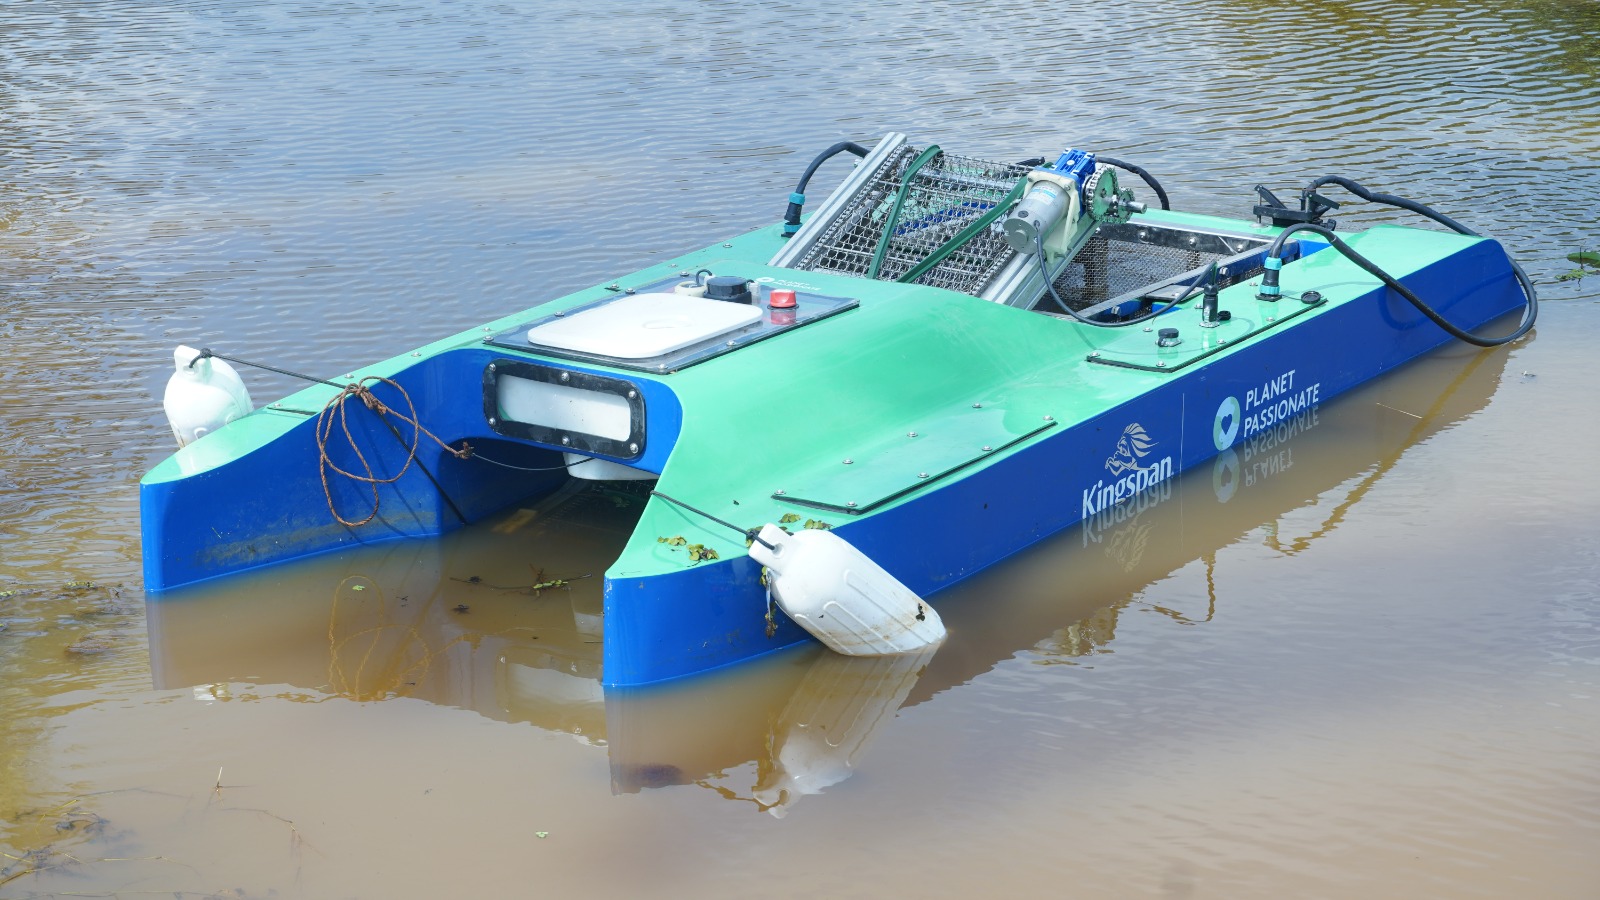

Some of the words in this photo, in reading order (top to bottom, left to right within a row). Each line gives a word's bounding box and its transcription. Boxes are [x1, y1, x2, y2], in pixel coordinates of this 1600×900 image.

[1243, 383, 1320, 437] PASSIONATE
[1246, 370, 1295, 410] PLANET
[1082, 456, 1172, 519] Kingspan
